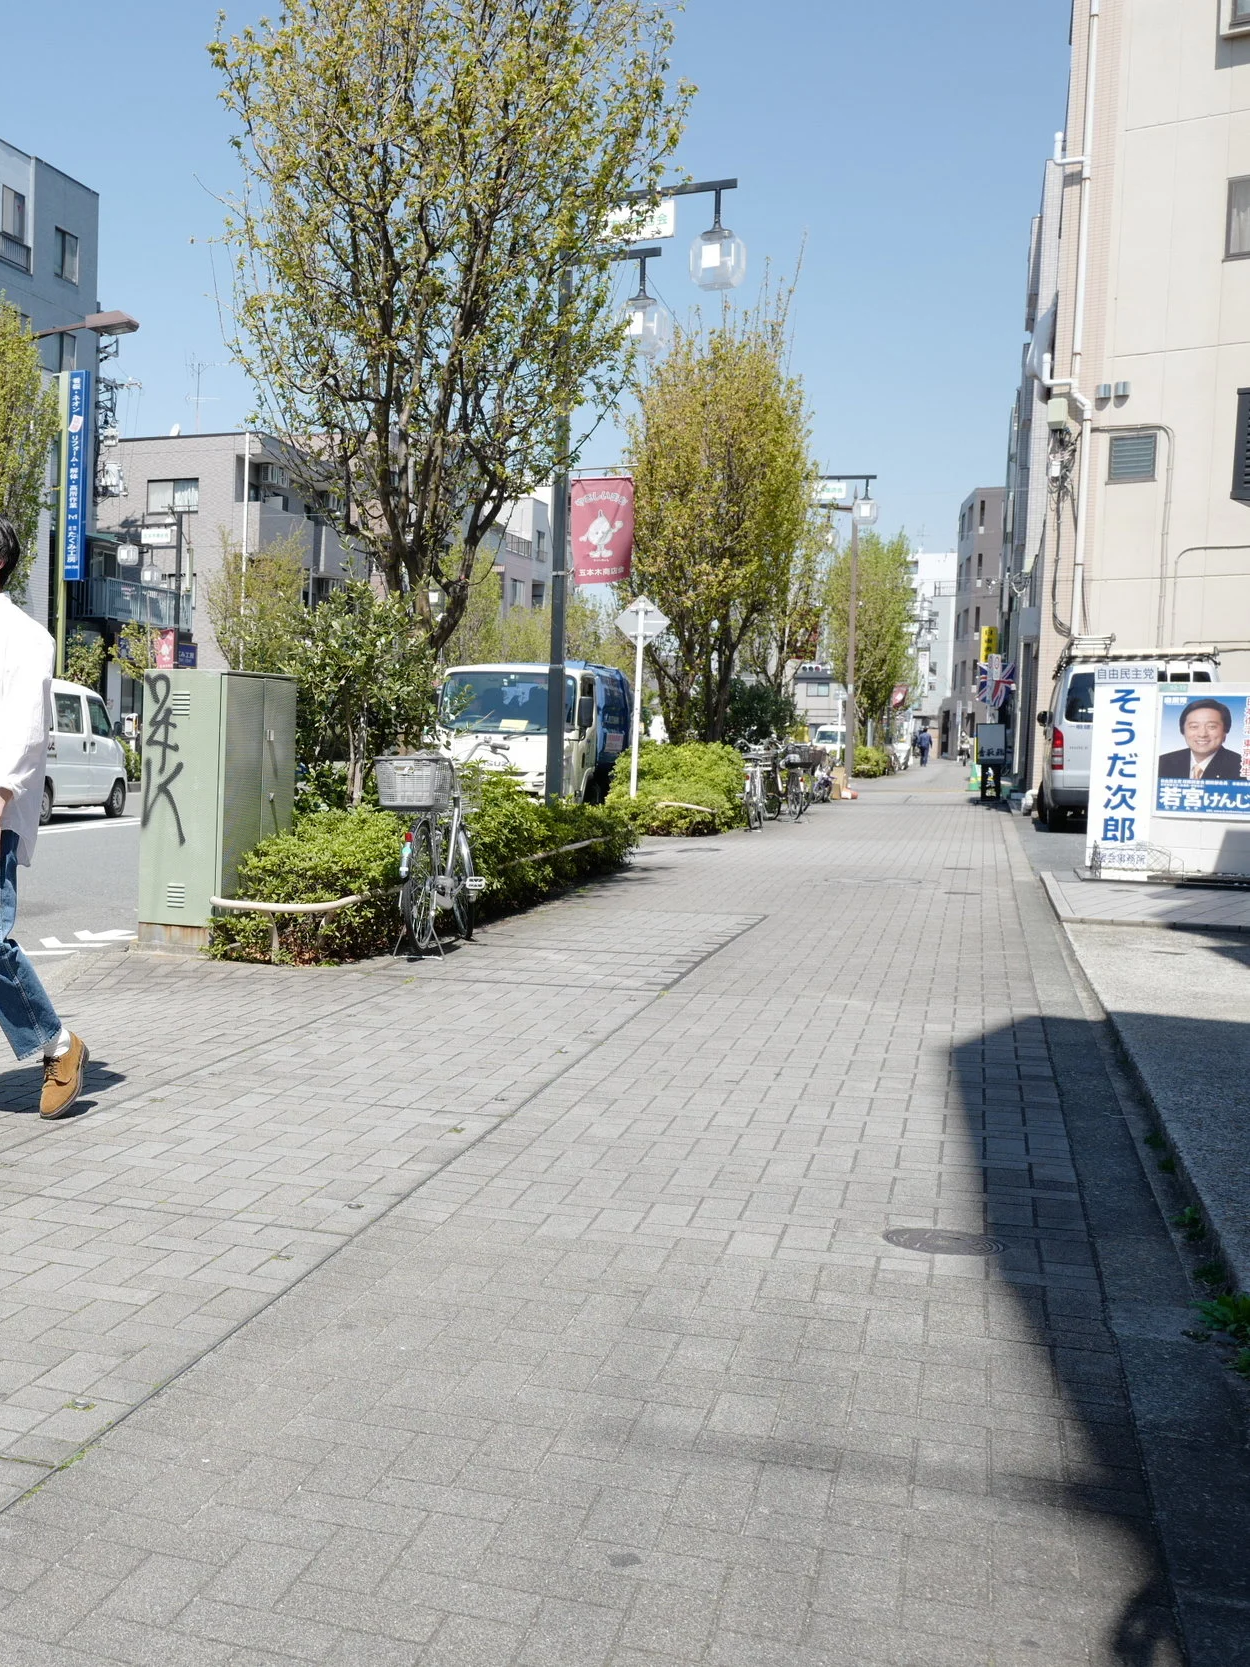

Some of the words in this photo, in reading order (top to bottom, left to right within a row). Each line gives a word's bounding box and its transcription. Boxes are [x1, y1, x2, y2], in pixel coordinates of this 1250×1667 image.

[66, 531, 78, 563] たくみ工房
[578, 566, 625, 577] 五本木商店会
[1096, 668, 1154, 680] 自由民主党
[1101, 689, 1140, 844] そうだ次郎
[1158, 786, 1250, 809] 若宮けんじ
[1090, 850, 1146, 865] 援会事務所
